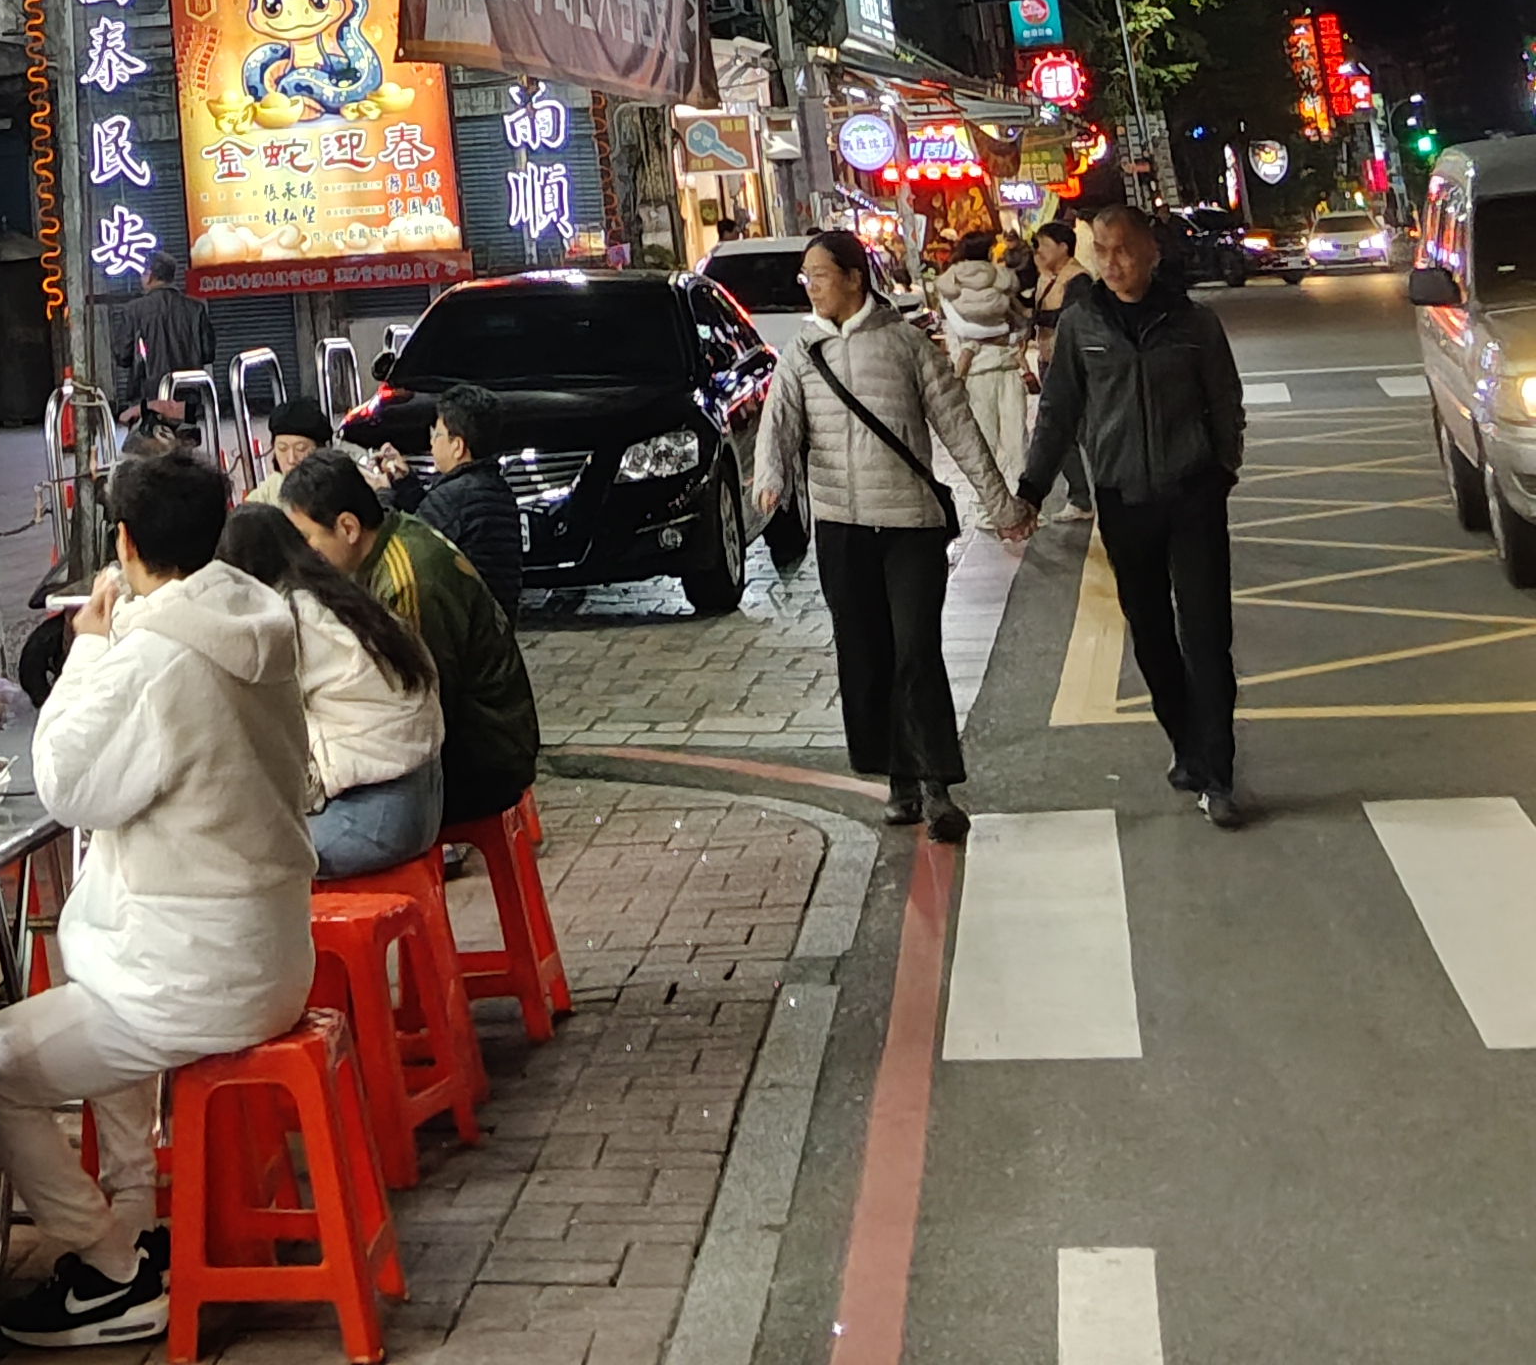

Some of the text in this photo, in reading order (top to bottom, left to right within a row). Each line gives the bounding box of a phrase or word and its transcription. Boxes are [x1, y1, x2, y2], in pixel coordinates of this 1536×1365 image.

[201, 121, 436, 183] 金蛇迎春
[502, 80, 574, 239] 雨順
